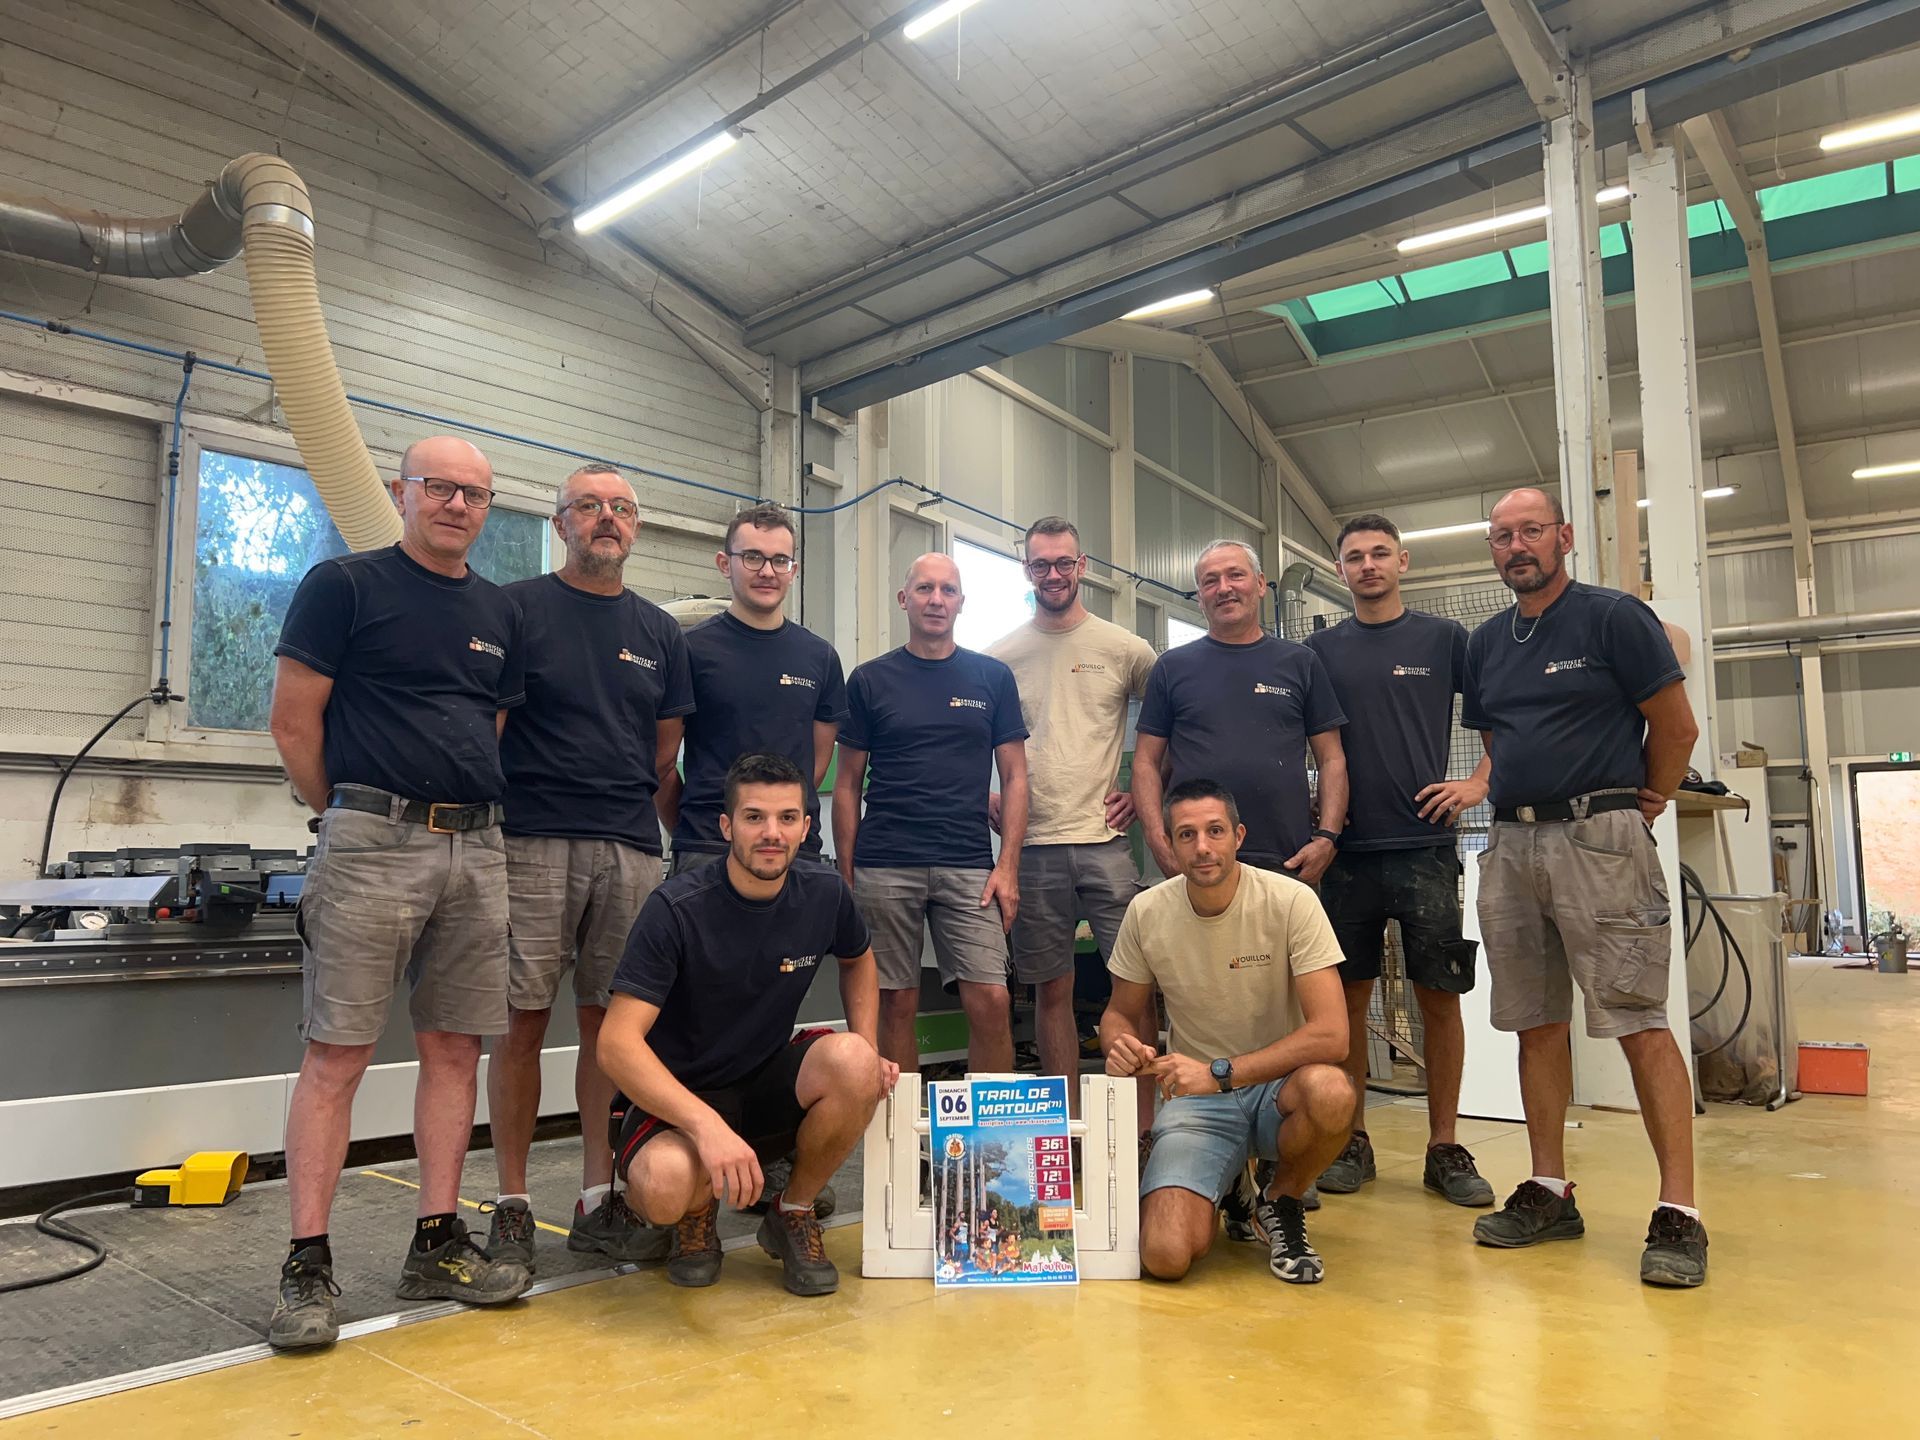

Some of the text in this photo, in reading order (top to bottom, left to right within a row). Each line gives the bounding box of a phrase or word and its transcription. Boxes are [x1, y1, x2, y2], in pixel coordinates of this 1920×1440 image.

[977, 1087, 1050, 1101] TRAIL DE
[941, 1095, 967, 1114] 06
[978, 1102, 1049, 1115] MATOUR
[1041, 1138, 1059, 1150] 36
[1041, 1154, 1060, 1166] 24
[1043, 1170, 1058, 1182] 12
[1044, 1185, 1054, 1196] 5
[421, 1218, 442, 1230] CAT
